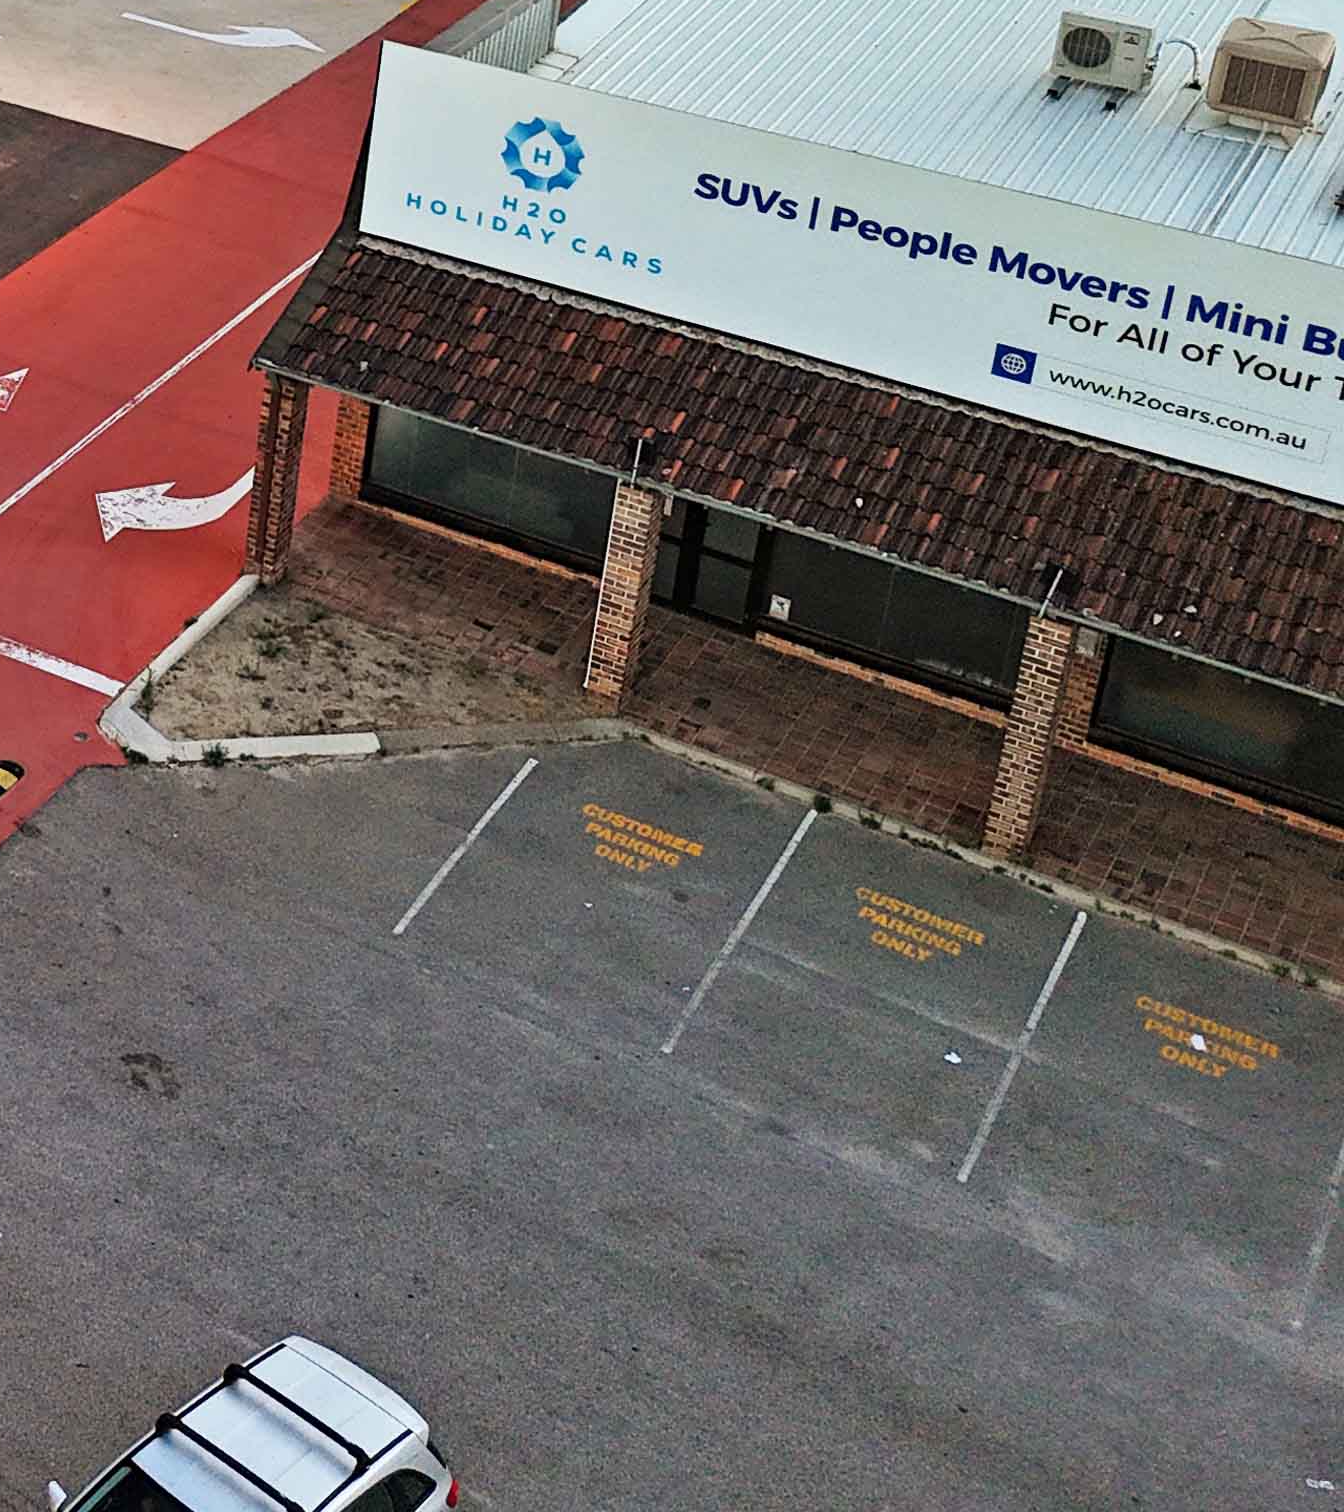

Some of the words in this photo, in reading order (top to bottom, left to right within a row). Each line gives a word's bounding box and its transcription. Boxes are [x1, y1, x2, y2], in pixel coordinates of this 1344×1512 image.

[533, 147, 552, 167] H
[406, 192, 555, 246] HOLIDAY
[571, 237, 664, 276] CARS
[694, 172, 799, 221] SUVs
[830, 205, 978, 266] People
[987, 245, 1150, 311] Movers
[1185, 293, 1288, 345] Mini
[1047, 303, 1109, 339] For
[1117, 324, 1168, 356] All
[1180, 341, 1223, 367] of
[1232, 348, 1323, 396] Your
[1048, 368, 1309, 453] www.h2ocars.com.au
[582, 802, 704, 857] CUSTOMER
[585, 822, 681, 868] PARKING
[595, 843, 652, 872] ONLY
[855, 887, 985, 946] CUSTOMER
[858, 906, 961, 957] PARKING
[871, 930, 931, 961] ONLY
[1136, 994, 1280, 1059] CUSTOMER
[1143, 1018, 1257, 1070] PARING
[1160, 1045, 1229, 1078] ONLY
